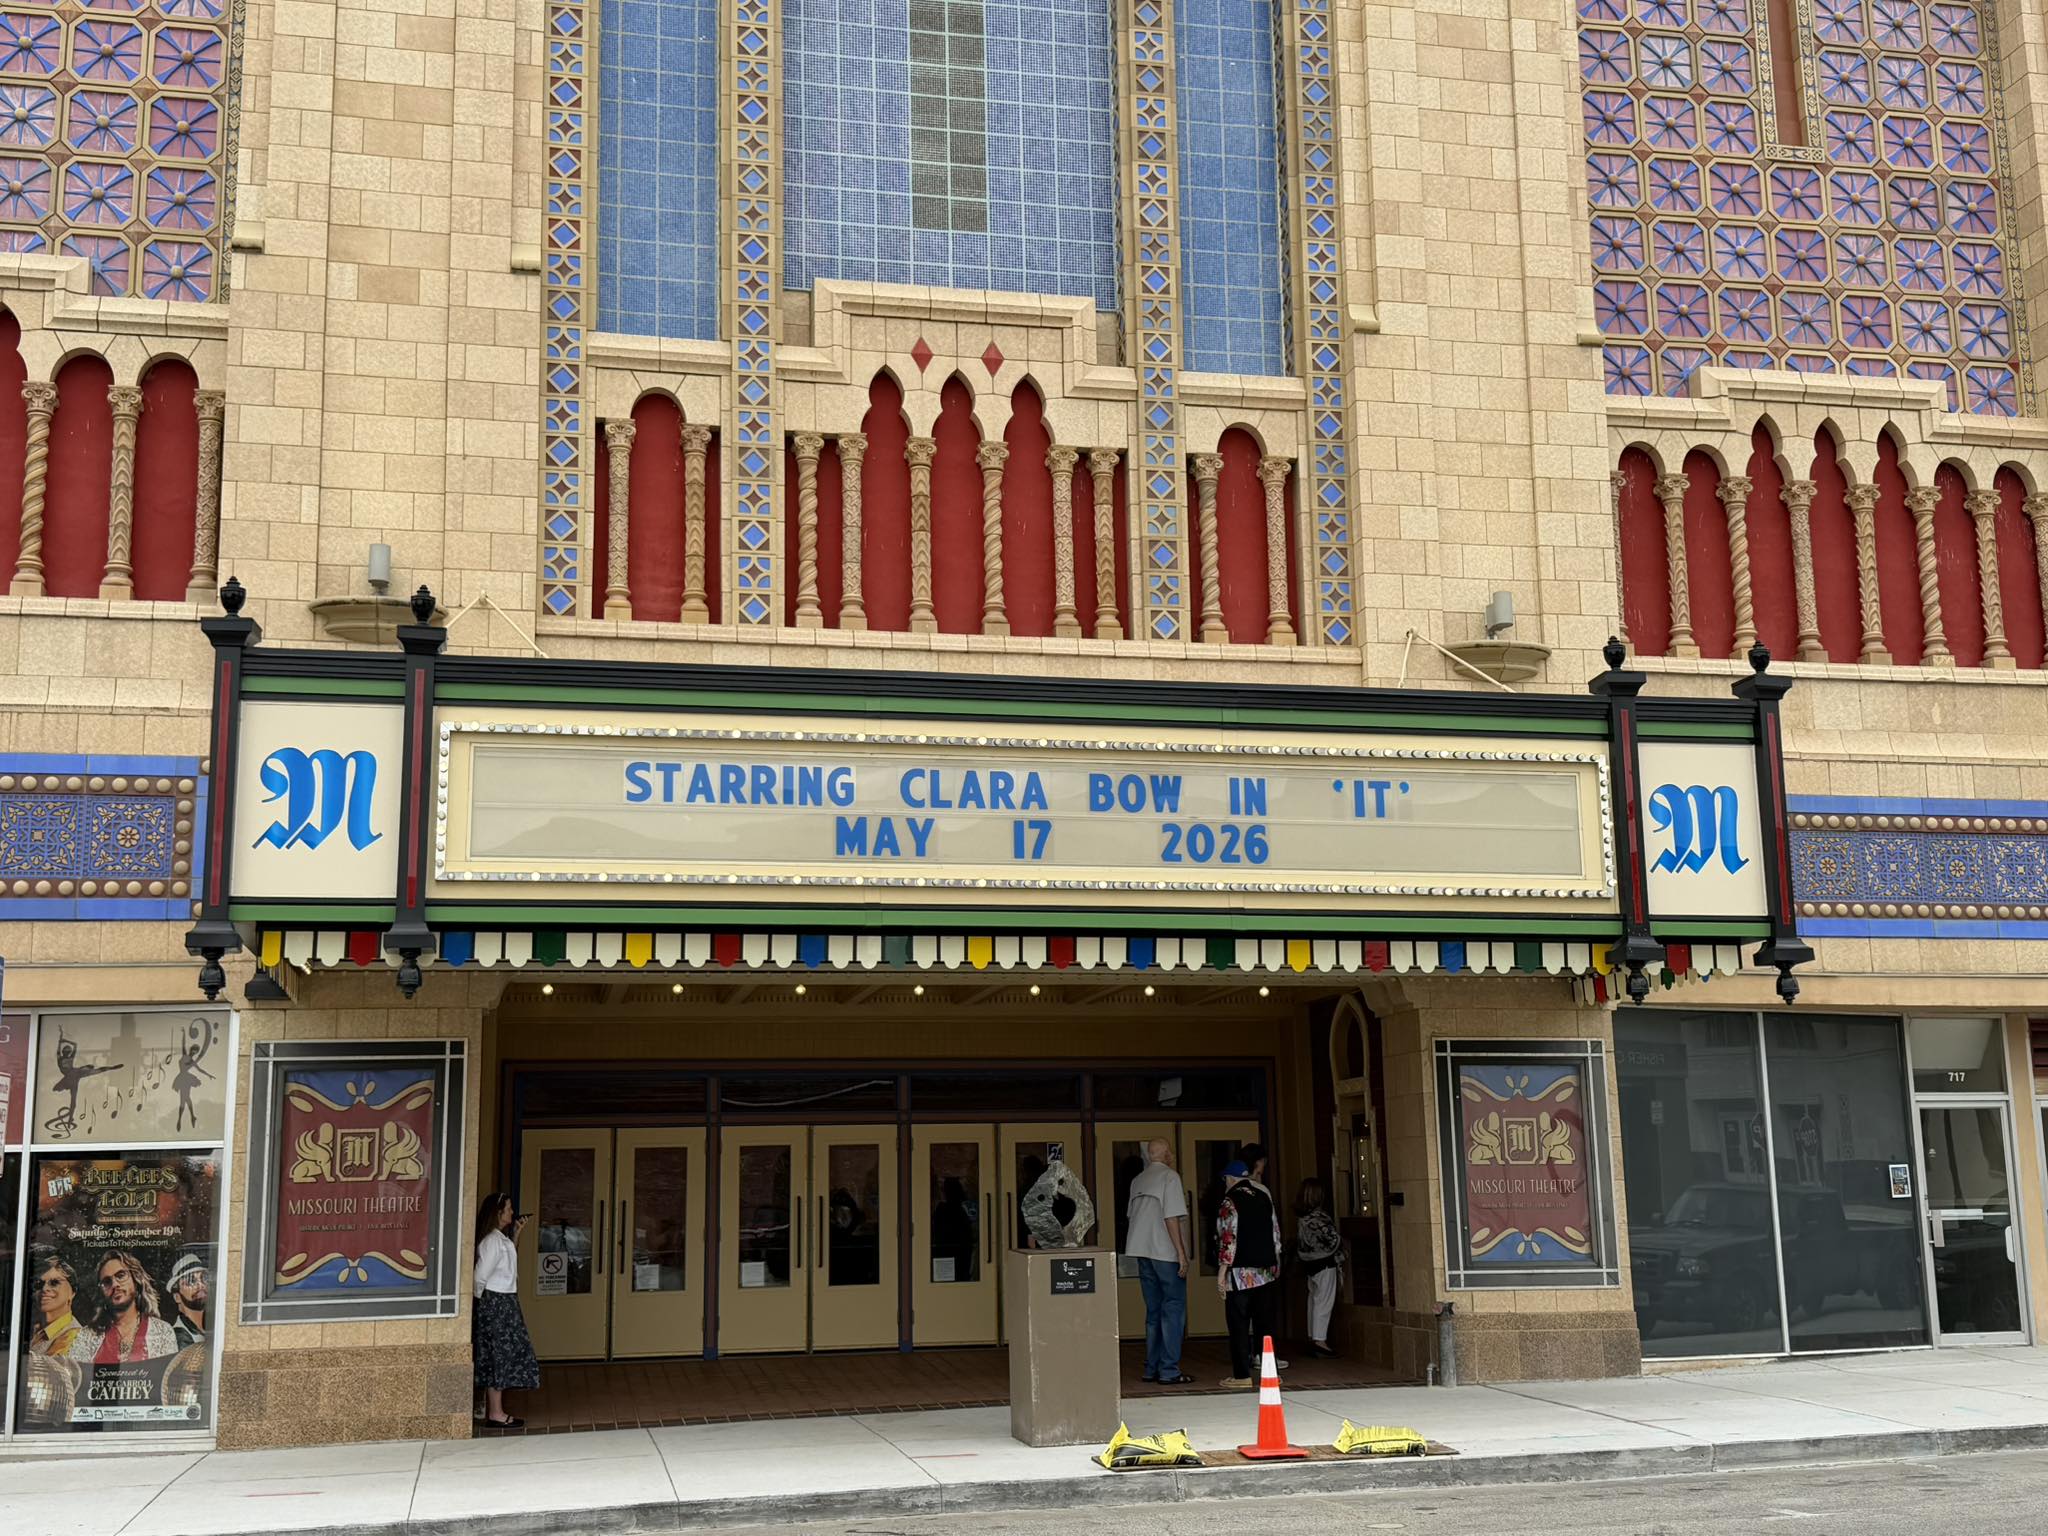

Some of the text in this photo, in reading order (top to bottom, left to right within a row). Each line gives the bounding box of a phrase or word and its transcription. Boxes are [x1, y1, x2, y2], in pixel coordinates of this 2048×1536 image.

[626, 762, 856, 808] STARRING
[900, 768, 1048, 813] CLARA
[1089, 773, 1182, 814] BOW
[1230, 778, 1267, 818] IN
[251, 747, 383, 851] M
[1648, 783, 1749, 876] M
[836, 816, 1269, 865] MAY 17 2026
[1947, 1072, 1965, 1082] 717
[1470, 1179, 1576, 1193] MISSOURI THEATRE
[289, 1196, 422, 1215] MISSOURI THEATRE
[68, 1225, 112, 1240] Saturday,
[112, 1226, 162, 1239] September
[82, 1239, 169, 1248] TicketsToTheShow.com
[95, 1368, 150, 1378] Sponsored by
[89, 1380, 107, 1388] PAT
[115, 1379, 154, 1388] CARROLL
[87, 1386, 153, 1401] CATHEY
